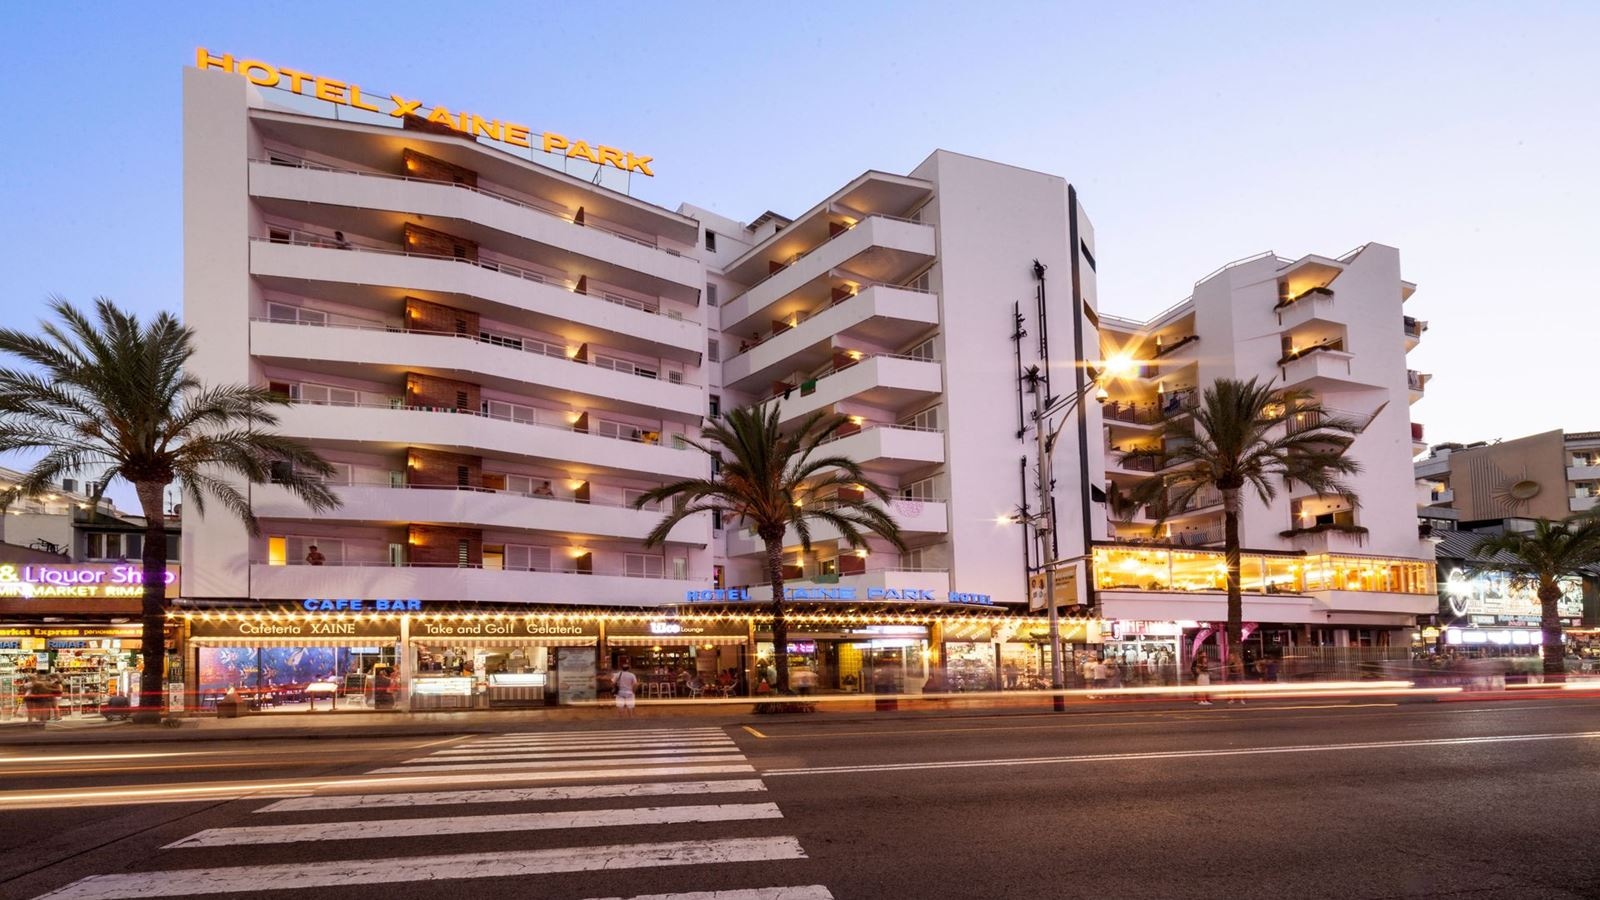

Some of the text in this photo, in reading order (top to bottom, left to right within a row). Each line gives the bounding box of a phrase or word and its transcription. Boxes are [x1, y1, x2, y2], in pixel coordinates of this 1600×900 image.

[196, 47, 655, 177] HOTEL XAINE PARK
[0, 565, 175, 586] & Liquor Shp
[105, 586, 144, 596] RIMA
[686, 587, 993, 605] HOTEL AINE PARK HOTEL
[304, 598, 422, 611] CAFE BAR
[34, 628, 79, 637] Express
[239, 623, 356, 635] Cafeteria XAINE
[424, 624, 453, 635] Take
[457, 624, 481, 634] and
[526, 624, 582, 634] Gelateria
